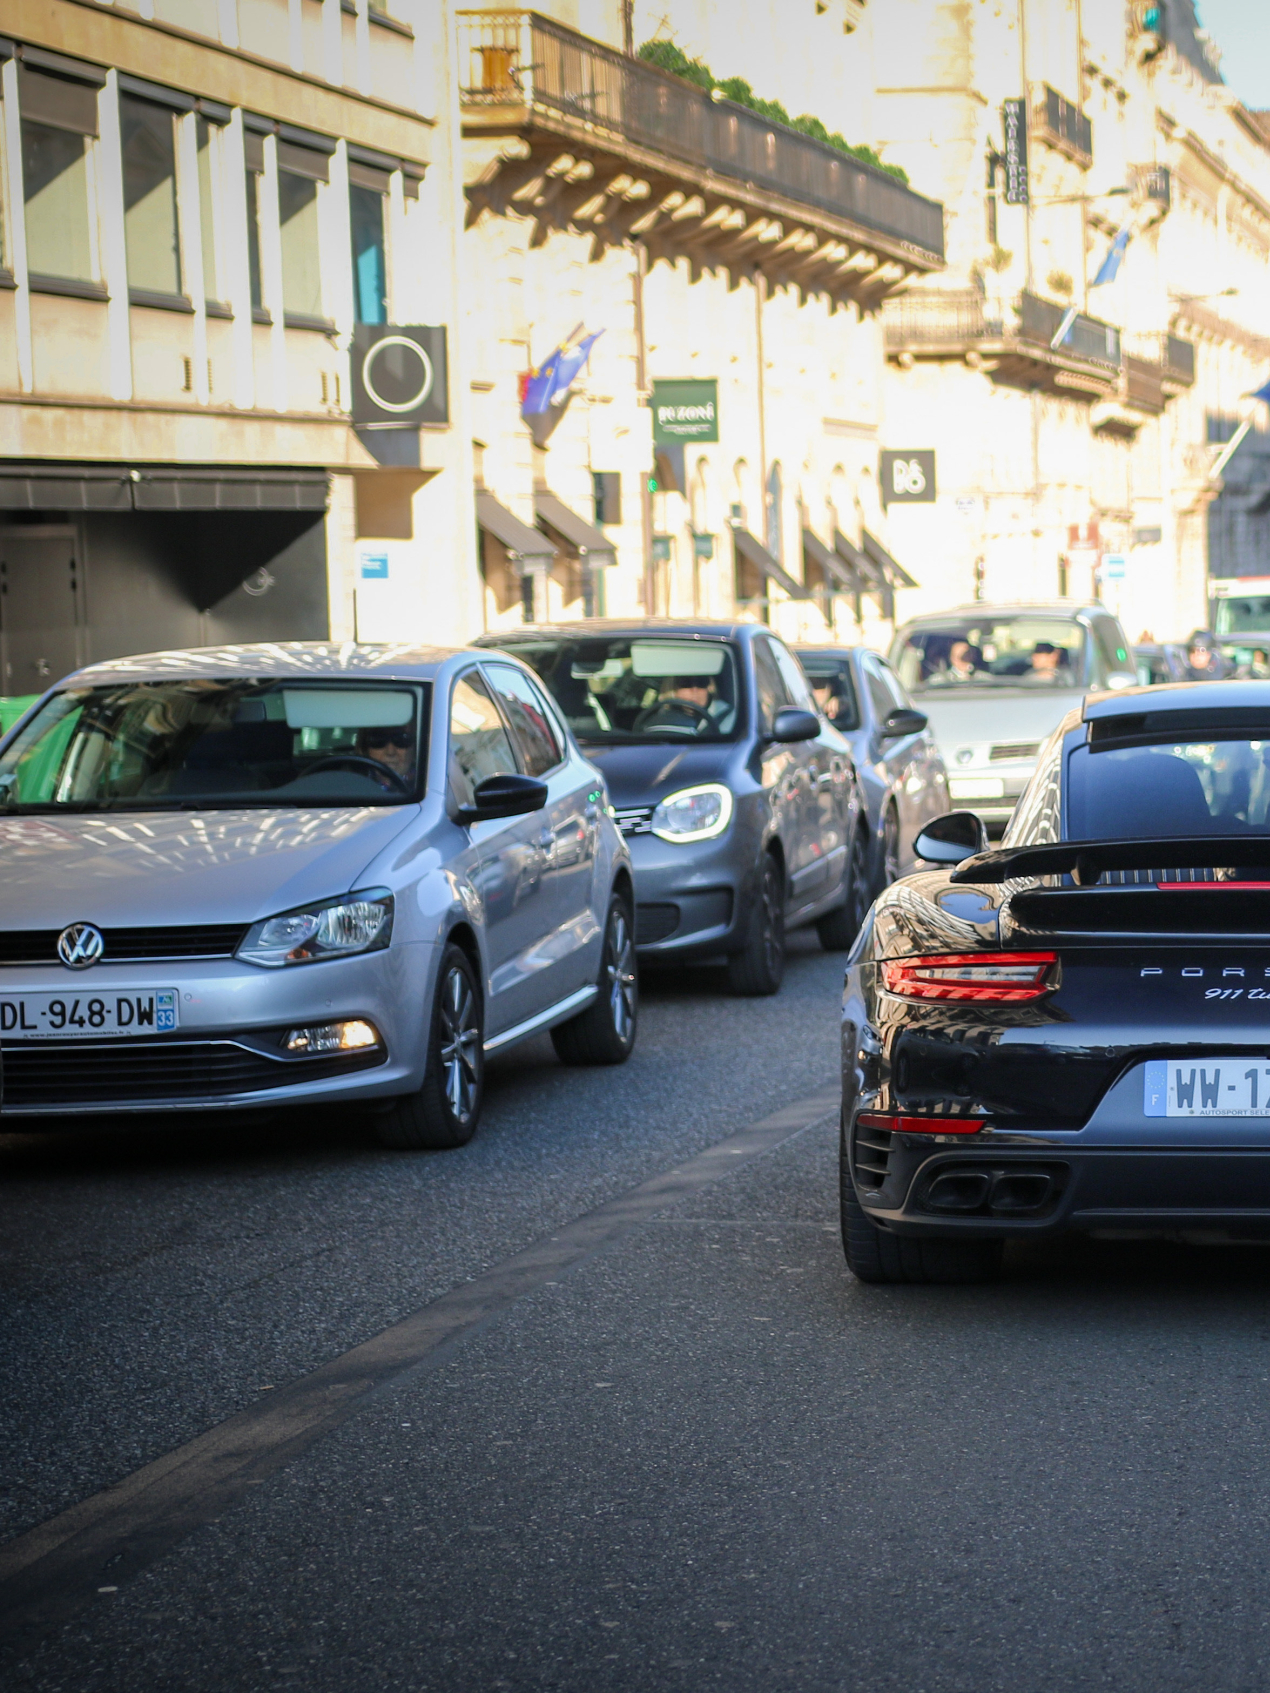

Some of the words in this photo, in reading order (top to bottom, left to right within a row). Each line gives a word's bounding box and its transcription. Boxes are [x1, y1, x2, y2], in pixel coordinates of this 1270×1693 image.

[1204, 988, 1245, 1000] 911
[0, 996, 154, 1031] DL-948-DW
[157, 1009, 174, 1027] 33
[1151, 1094, 1160, 1106] F
